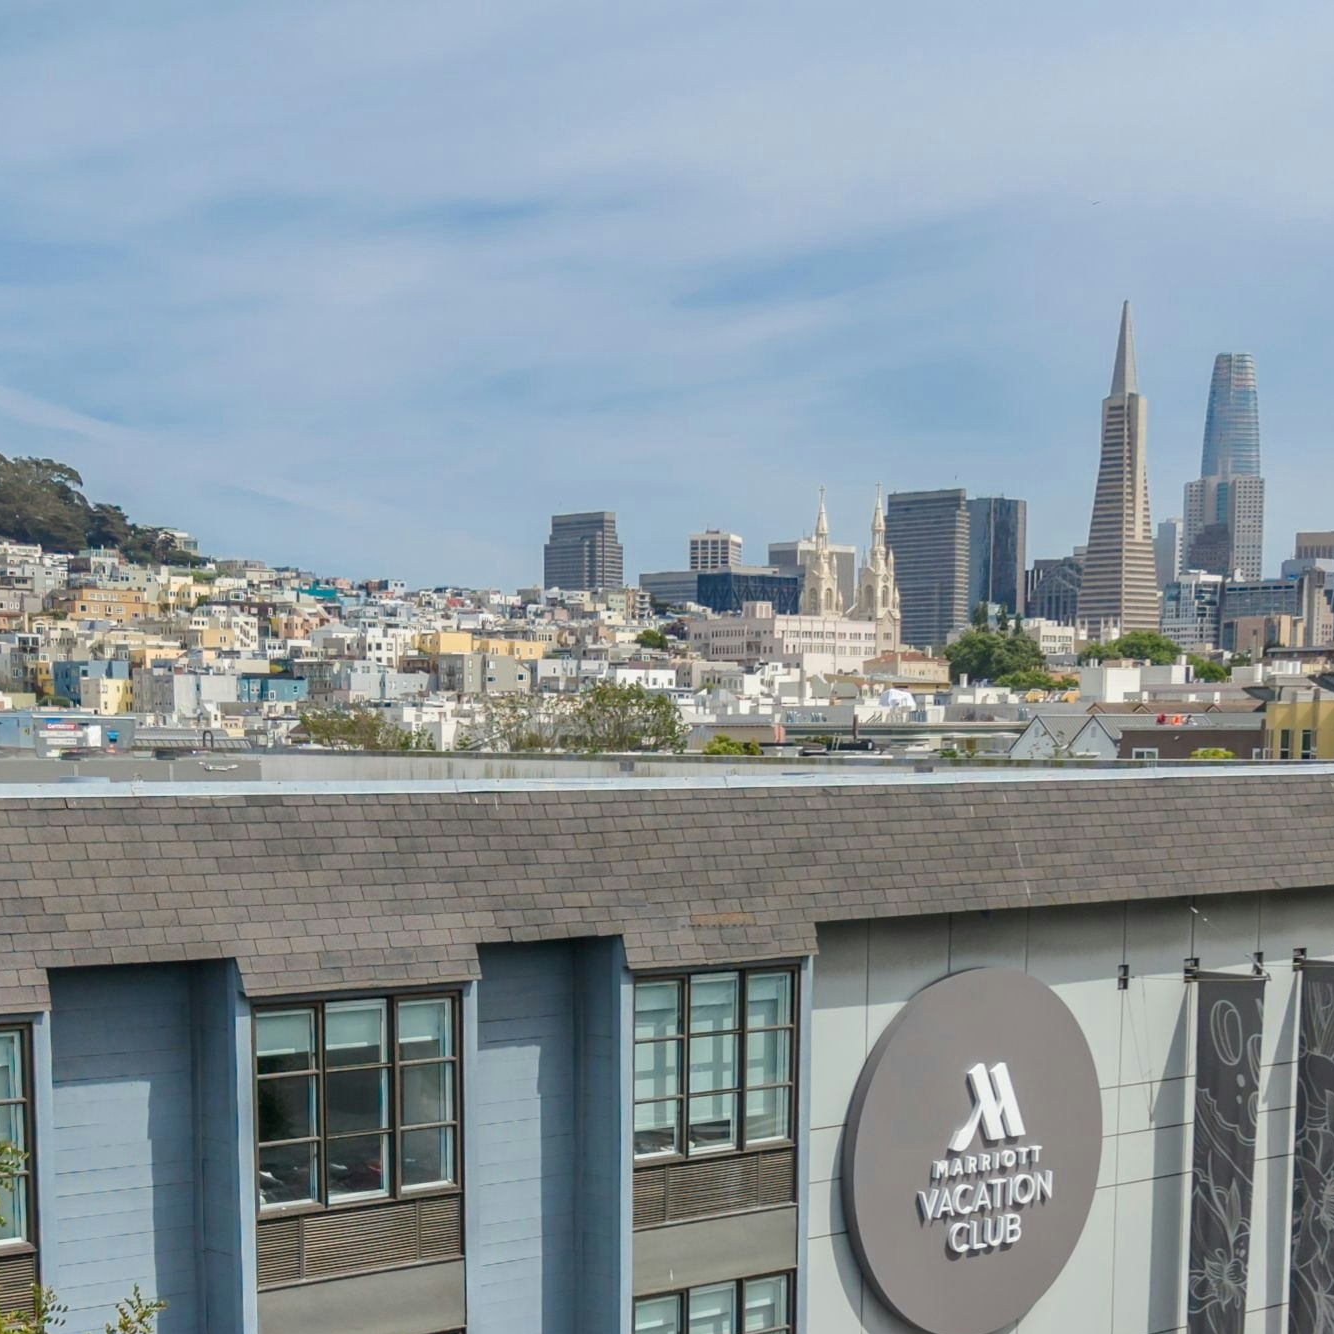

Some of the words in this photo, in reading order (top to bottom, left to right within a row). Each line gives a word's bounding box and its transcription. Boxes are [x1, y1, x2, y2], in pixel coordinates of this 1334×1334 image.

[932, 1145, 1043, 1179] MARRIOTT
[917, 1169, 1054, 1220] VACATION
[948, 1213, 1022, 1253] CLUB
